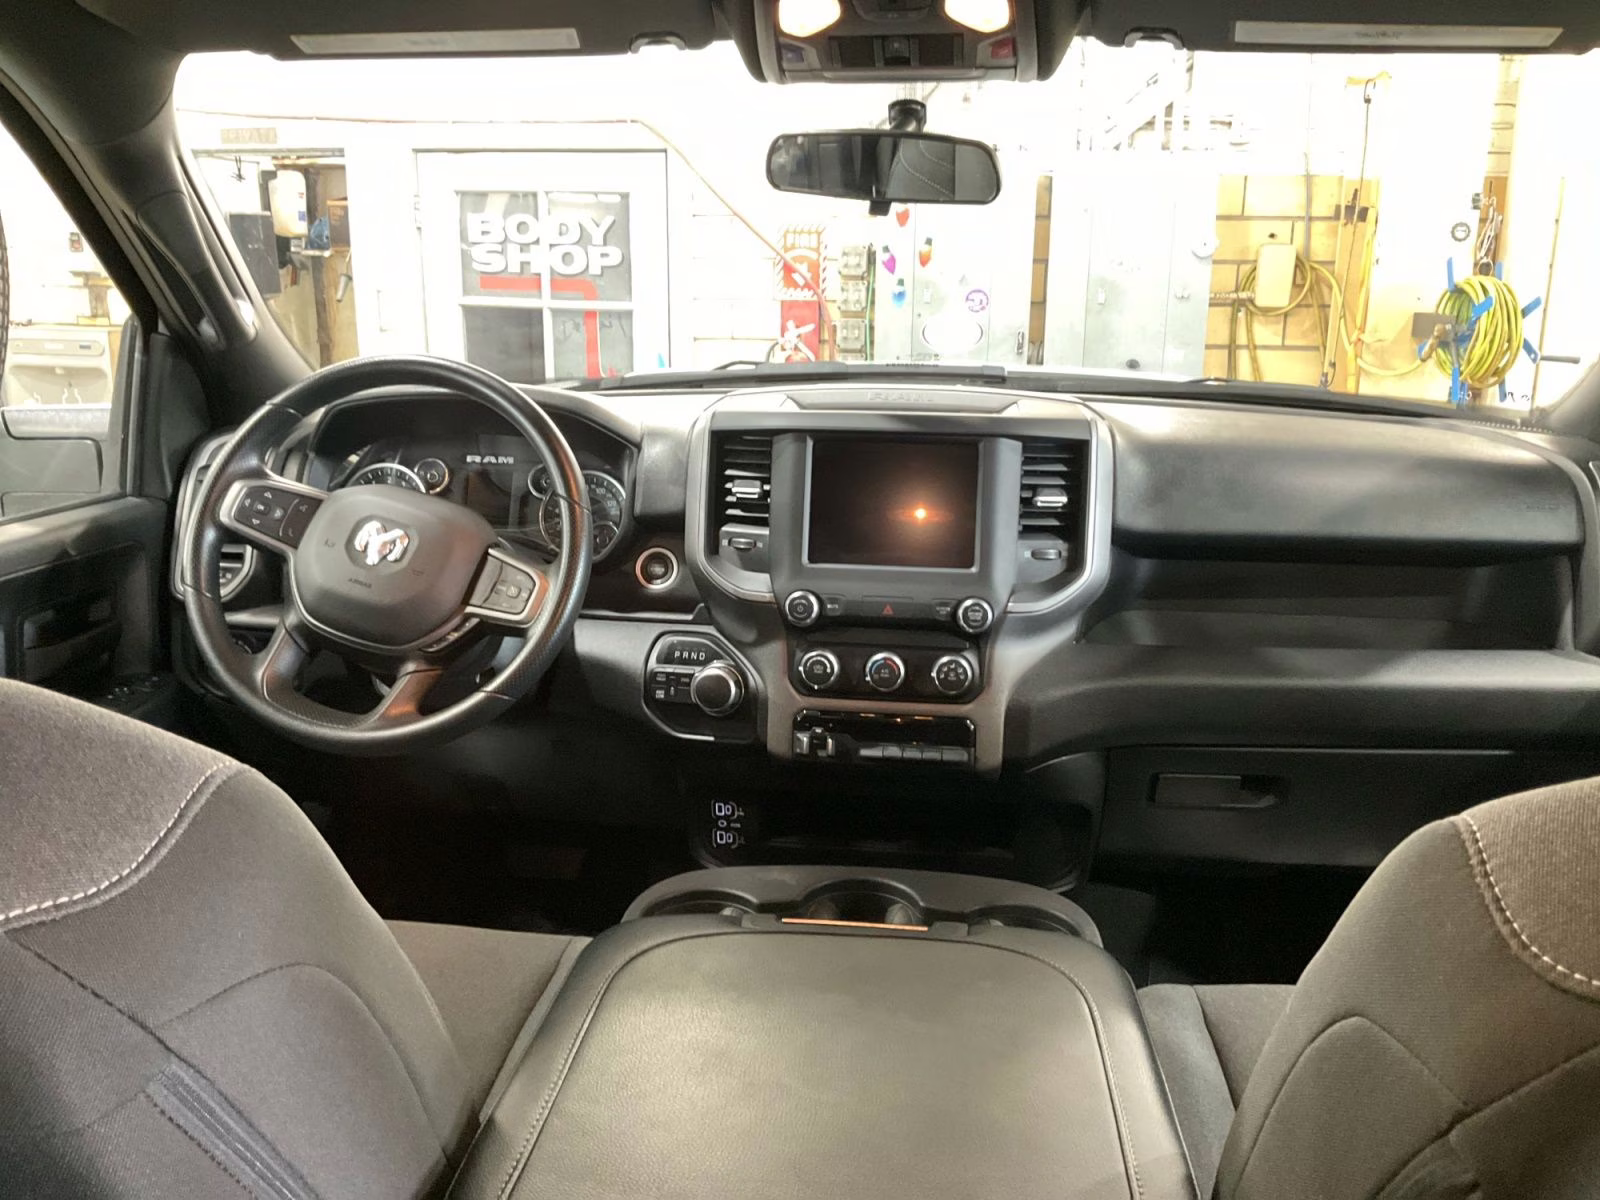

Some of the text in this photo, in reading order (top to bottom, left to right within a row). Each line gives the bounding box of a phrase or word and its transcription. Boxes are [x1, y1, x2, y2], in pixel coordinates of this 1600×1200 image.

[467, 212, 615, 245] BODY
[471, 243, 624, 275] SHOP
[466, 454, 515, 464] RAM
